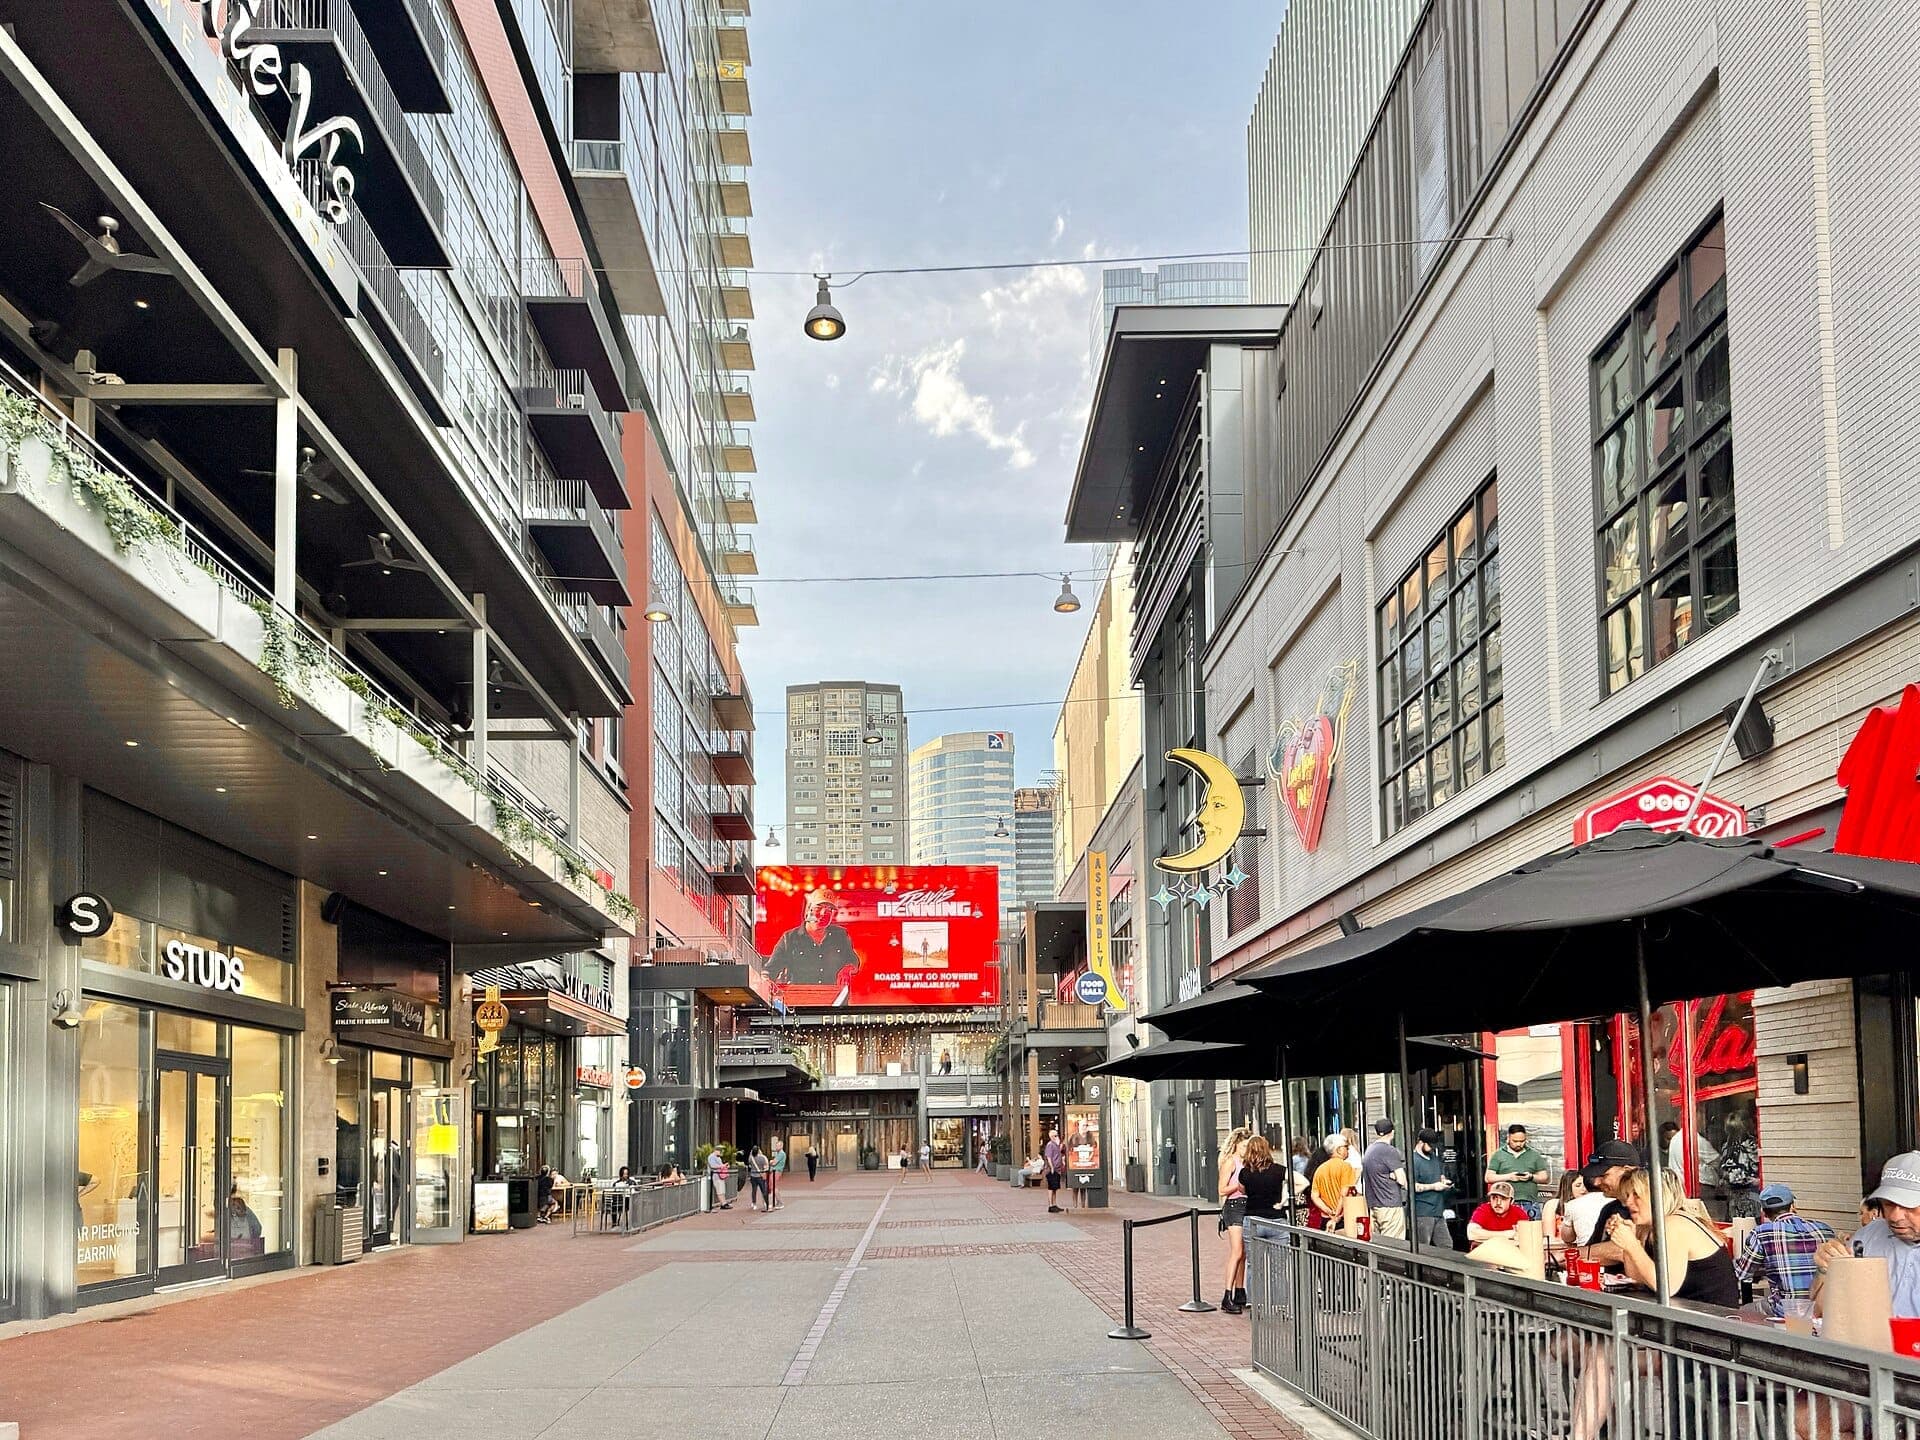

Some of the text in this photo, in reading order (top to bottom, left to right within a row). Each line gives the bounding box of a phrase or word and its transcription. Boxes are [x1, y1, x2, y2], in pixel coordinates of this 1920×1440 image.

[1642, 797, 1687, 809] HOT
[898, 886, 956, 906] TRAVIS
[70, 896, 100, 933] S
[877, 901, 971, 917] DENNING
[1095, 857, 1104, 968] ASSEMBLY
[166, 939, 244, 994] STUDS
[874, 973, 978, 981] ROADS THAT GO NOWHERE
[1080, 980, 1104, 988] FOOD
[1081, 988, 1104, 996] HALL
[822, 1015, 871, 1026] FIFTH
[885, 1012, 972, 1025] BROADWAY
[91, 1221, 140, 1241] PIERCING
